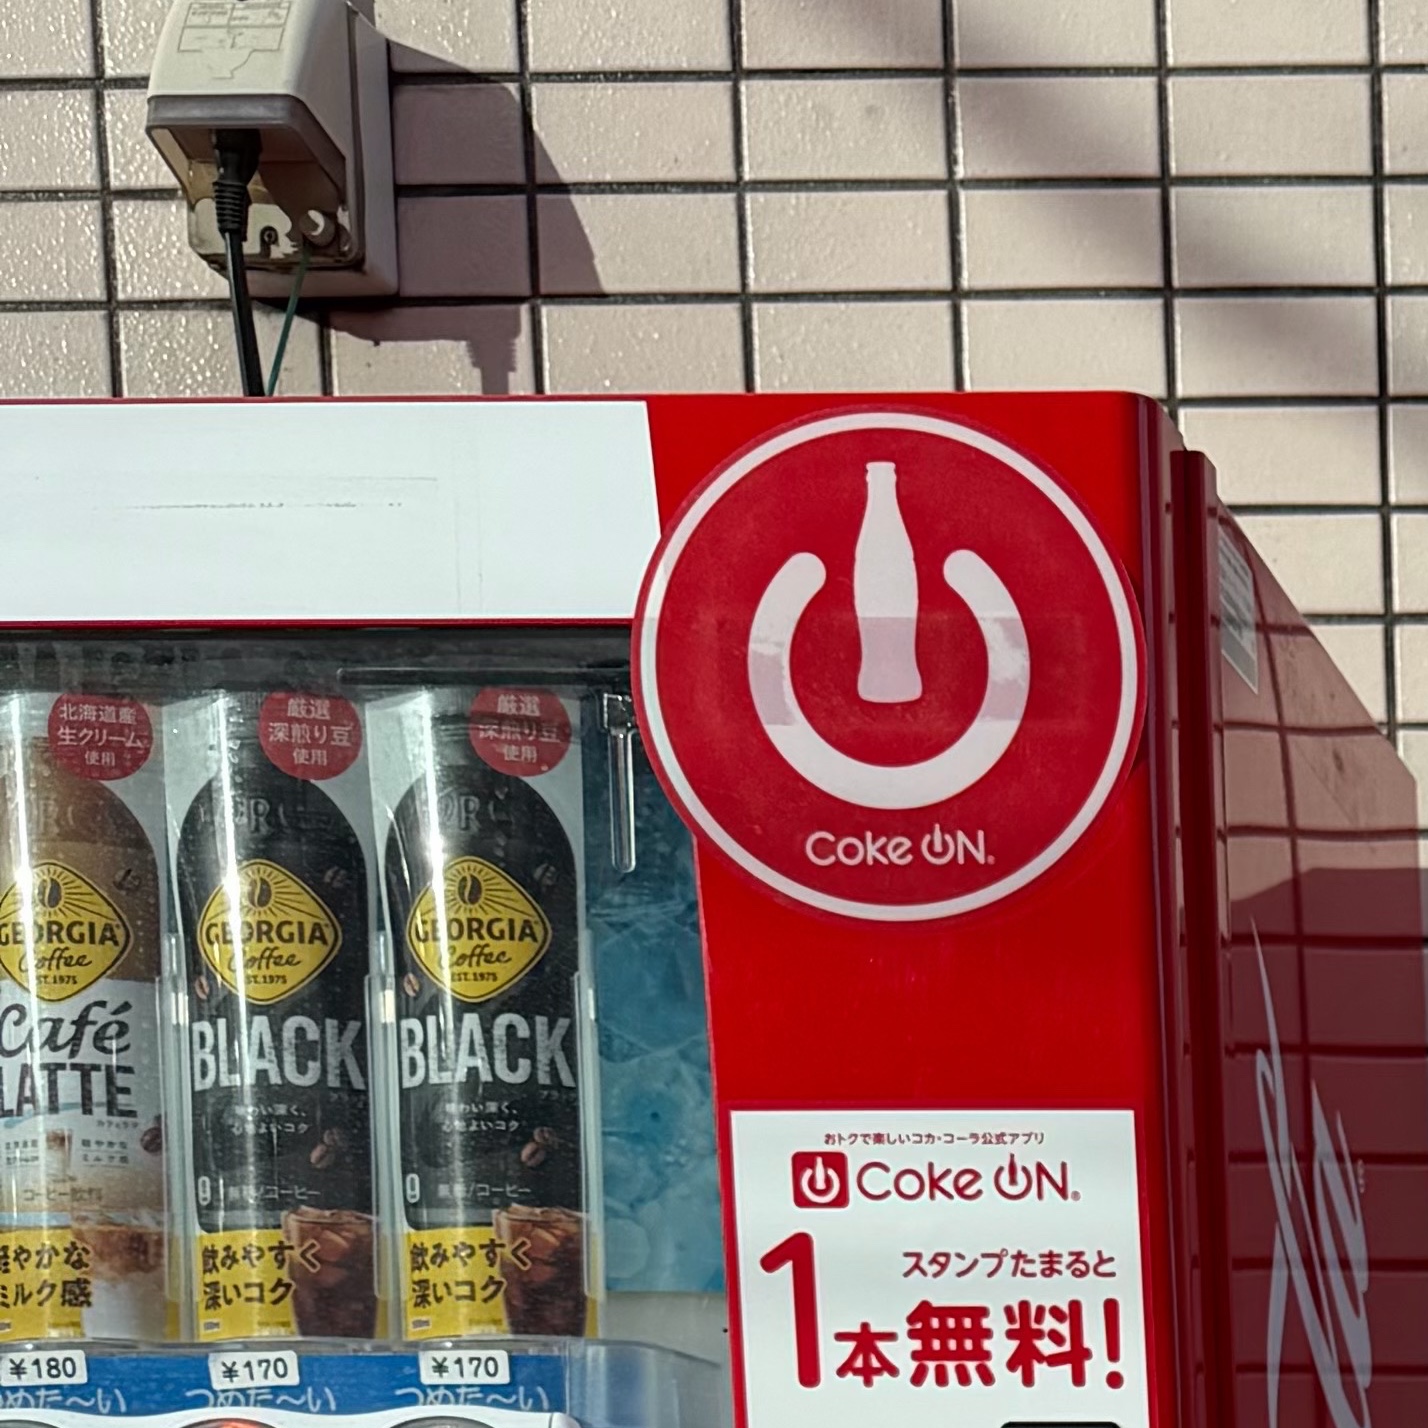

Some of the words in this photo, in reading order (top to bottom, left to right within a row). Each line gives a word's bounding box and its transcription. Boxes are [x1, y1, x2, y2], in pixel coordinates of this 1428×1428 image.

[57, 727, 144, 748] 生クリーム
[85, 750, 116, 767] 使用
[805, 830, 913, 867] Coke
[0, 920, 120, 947] GEORGIA
[204, 920, 330, 947] GEORGIA
[414, 917, 539, 944] GEORGIA
[19, 947, 93, 974] Coffee
[228, 946, 303, 973] Coffee
[439, 943, 512, 970] Coffee
[0, 1000, 134, 1060] Café
[192, 1014, 367, 1092] BLACK
[401, 1012, 577, 1090] BLACK
[0, 1063, 138, 1118] LATTE
[856, 1160, 984, 1201] Coke
[202, 1240, 321, 1274] 飲みやすく
[410, 1238, 532, 1272] 飲みやすく
[901, 1249, 1118, 1279] スタンプたまると
[759, 1231, 1125, 1390] 1本無料!
[9, 1357, 77, 1381] ¥180
[221, 1358, 289, 1383] ¥170
[431, 1356, 499, 1379] ¥170
